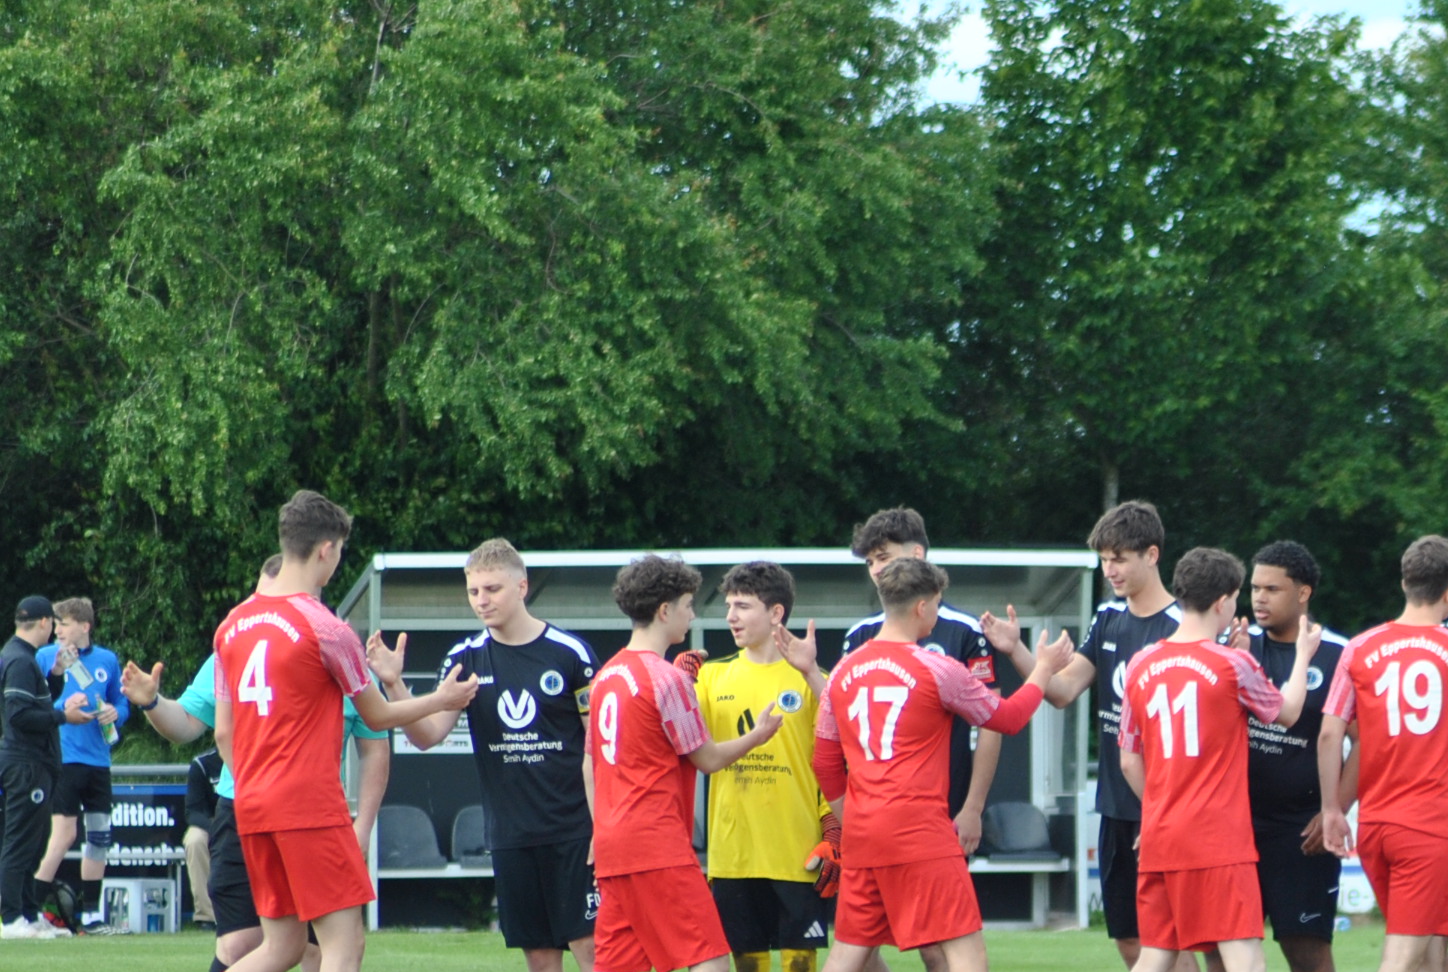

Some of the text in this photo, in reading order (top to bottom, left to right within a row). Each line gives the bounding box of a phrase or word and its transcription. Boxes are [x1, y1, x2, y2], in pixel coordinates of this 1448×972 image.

[237, 611, 301, 643] Eppertshausen
[841, 657, 918, 692] FV Eppertshausen
[1138, 655, 1219, 690] FV Eppertshausen
[1364, 650, 1380, 669] FV
[238, 639, 274, 717] 4
[1374, 659, 1443, 737] 19
[598, 691, 618, 765] 9
[847, 686, 910, 761] 17
[1146, 681, 1199, 759] 11
[522, 754, 544, 764] Aydin
[110, 802, 175, 827] dition.
